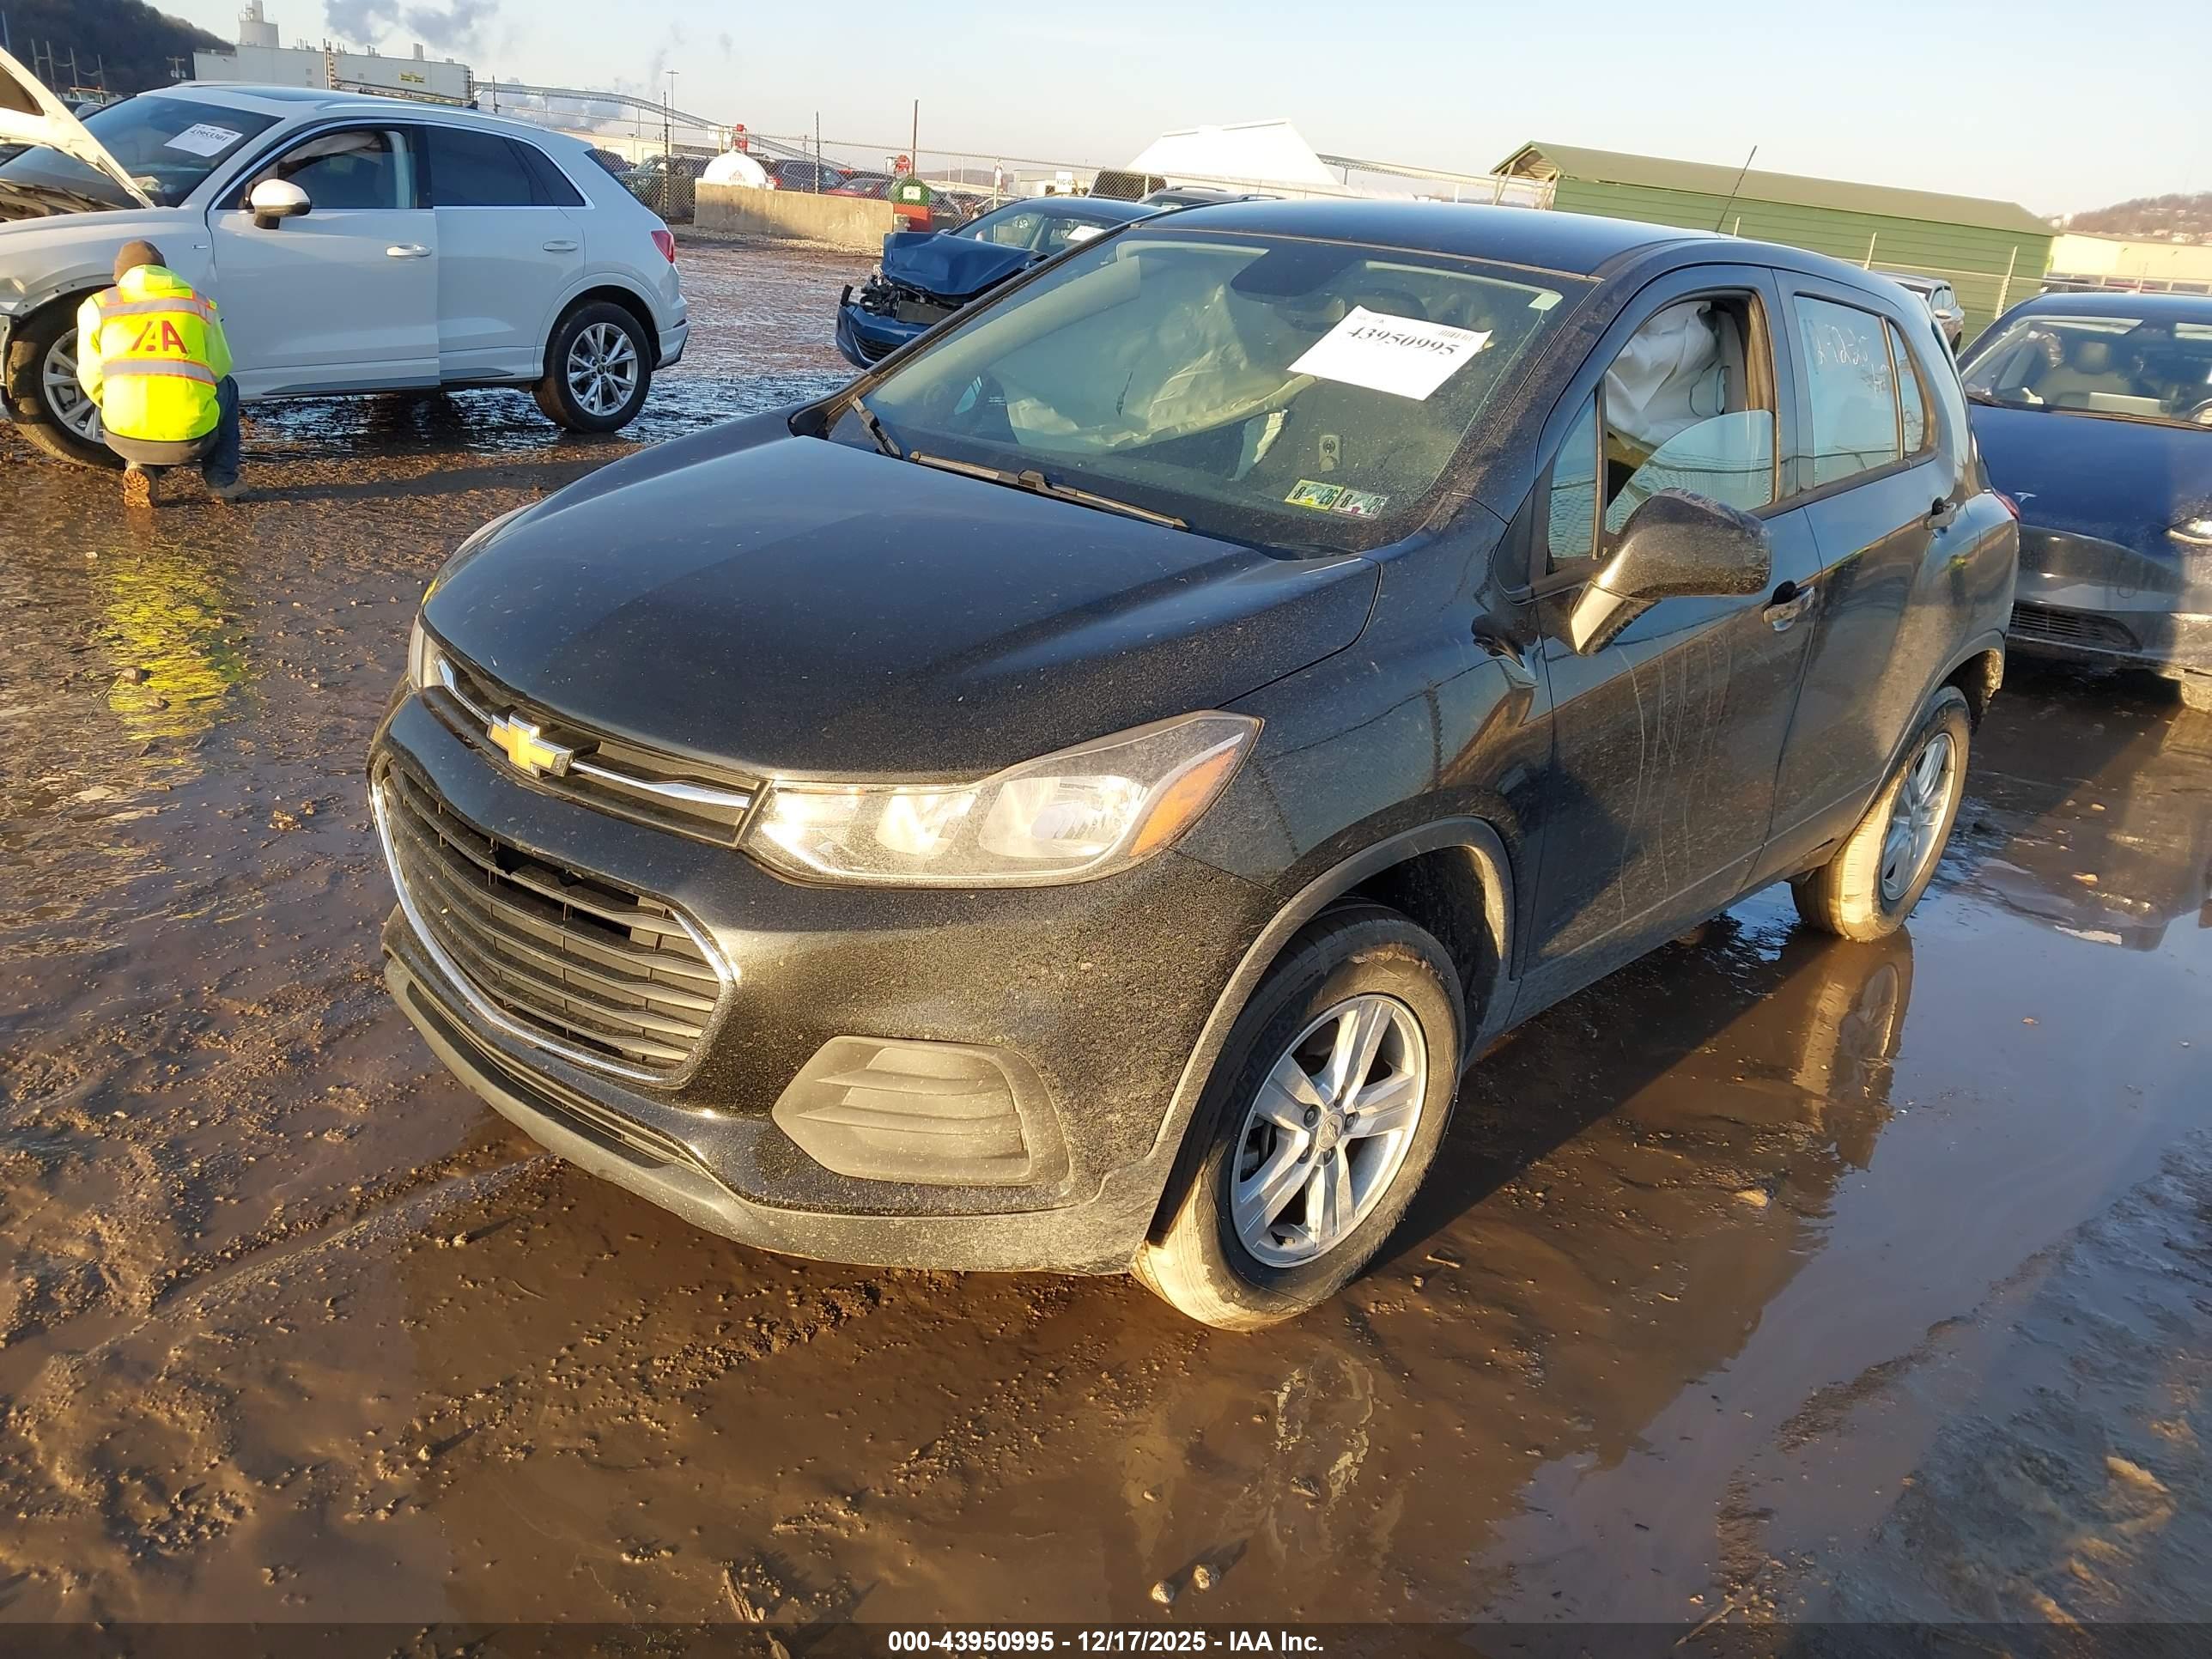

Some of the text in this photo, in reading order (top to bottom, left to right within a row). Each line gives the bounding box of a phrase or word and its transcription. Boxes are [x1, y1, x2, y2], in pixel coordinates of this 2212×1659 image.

[1346, 325, 1460, 357] 43950995
[1293, 486, 1339, 505] 8 26
[1340, 494, 1353, 508] 8
